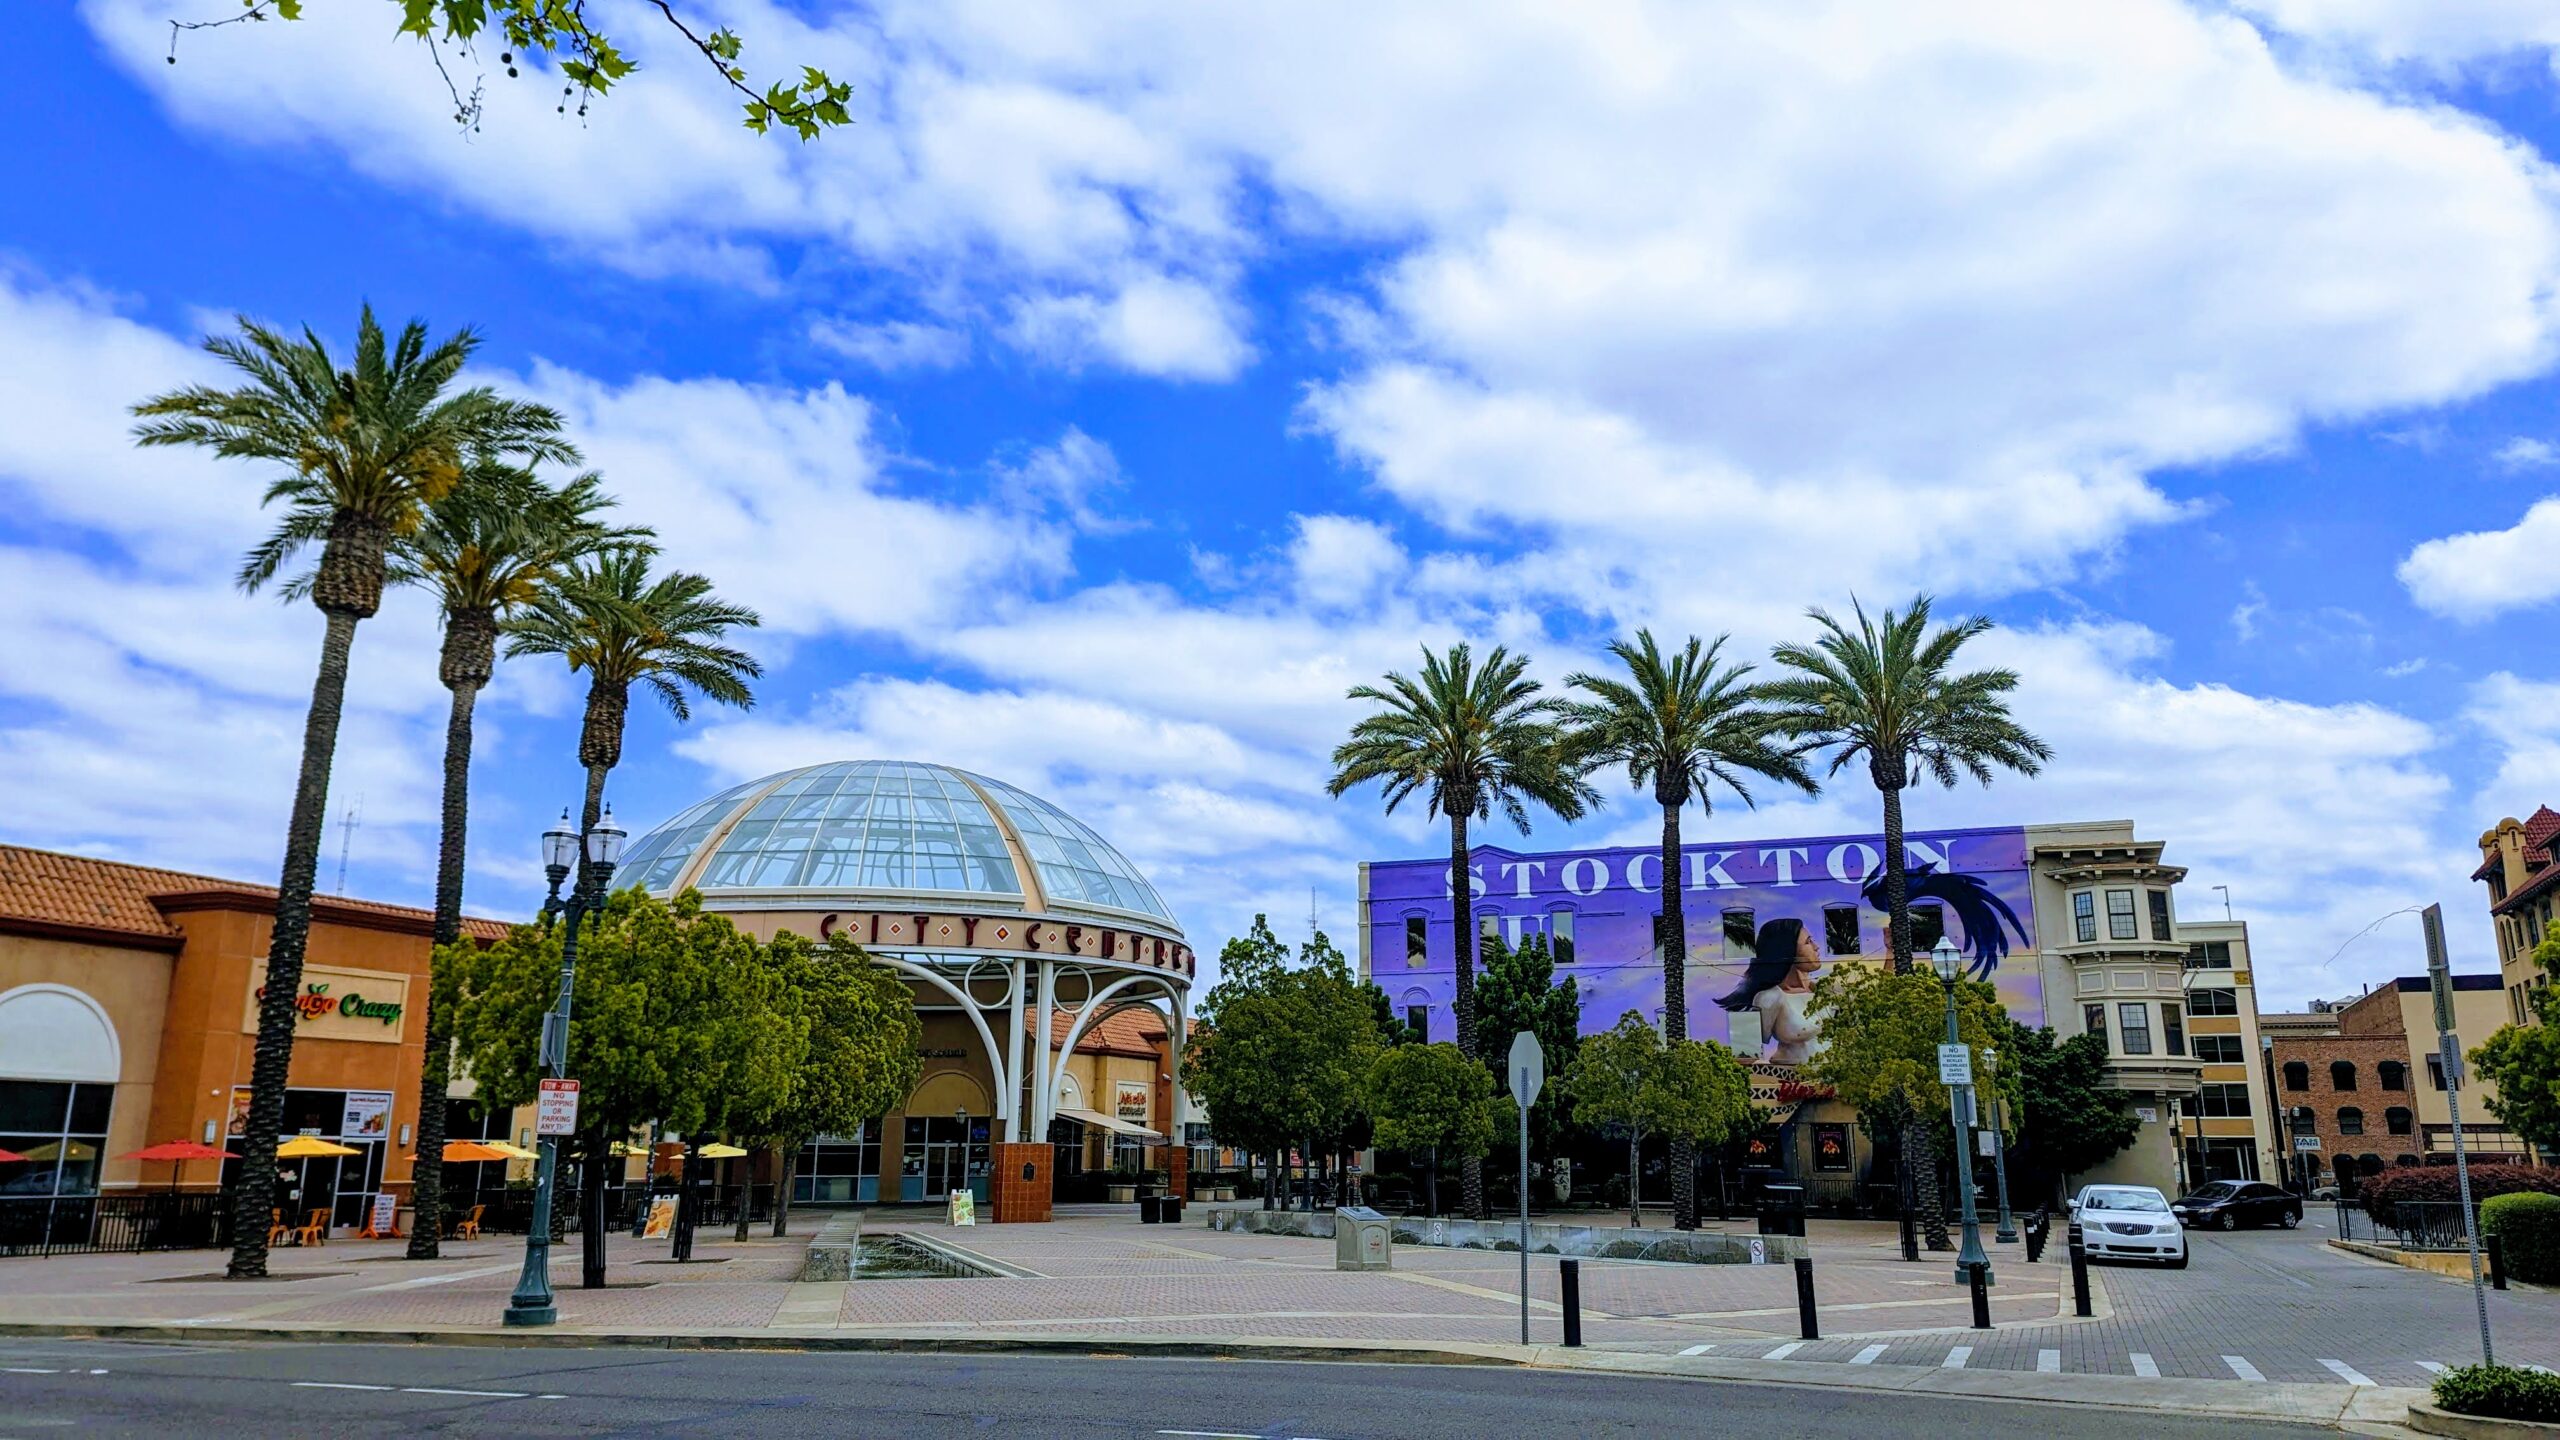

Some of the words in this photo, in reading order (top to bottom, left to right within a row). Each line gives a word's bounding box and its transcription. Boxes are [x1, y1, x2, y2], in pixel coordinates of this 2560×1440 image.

[1445, 839, 1958, 902] STOCKTON
[820, 913, 980, 946] CITY
[339, 993, 402, 1025] Crazy
